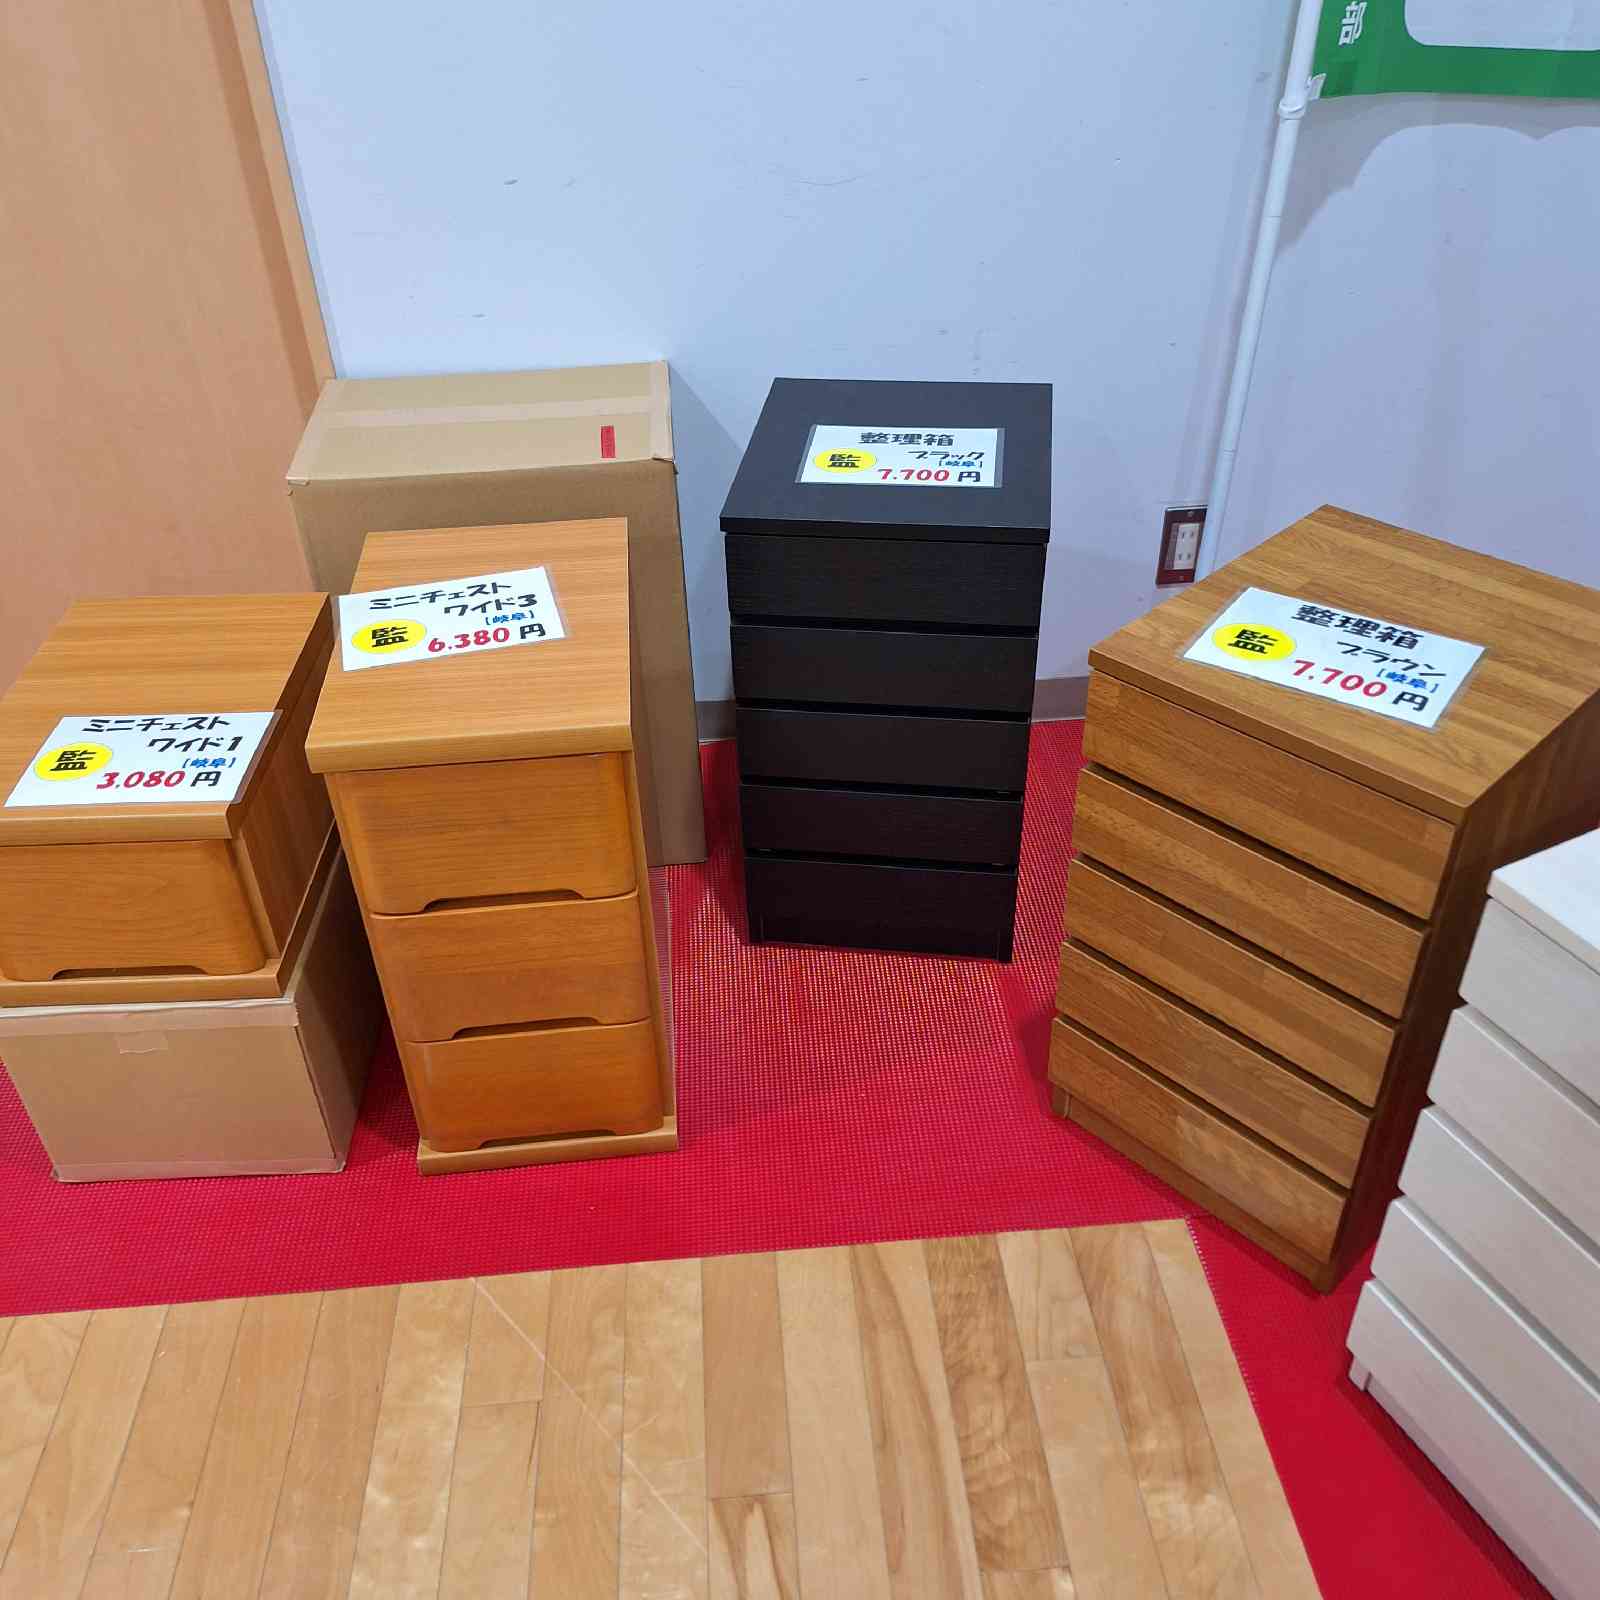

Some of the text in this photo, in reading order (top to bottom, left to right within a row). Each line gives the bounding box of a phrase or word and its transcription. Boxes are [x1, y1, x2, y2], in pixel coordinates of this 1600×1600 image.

[858, 432, 954, 447] 整理箱
[827, 453, 862, 468] 監
[369, 582, 512, 610] ミニチェスト
[371, 626, 409, 648] 監
[1291, 604, 1425, 650] 整理箱
[1227, 628, 1280, 655] 監
[1336, 641, 1447, 677] ブラウン
[81, 716, 231, 733] ミニチェスト
[50, 750, 97, 771] 監
